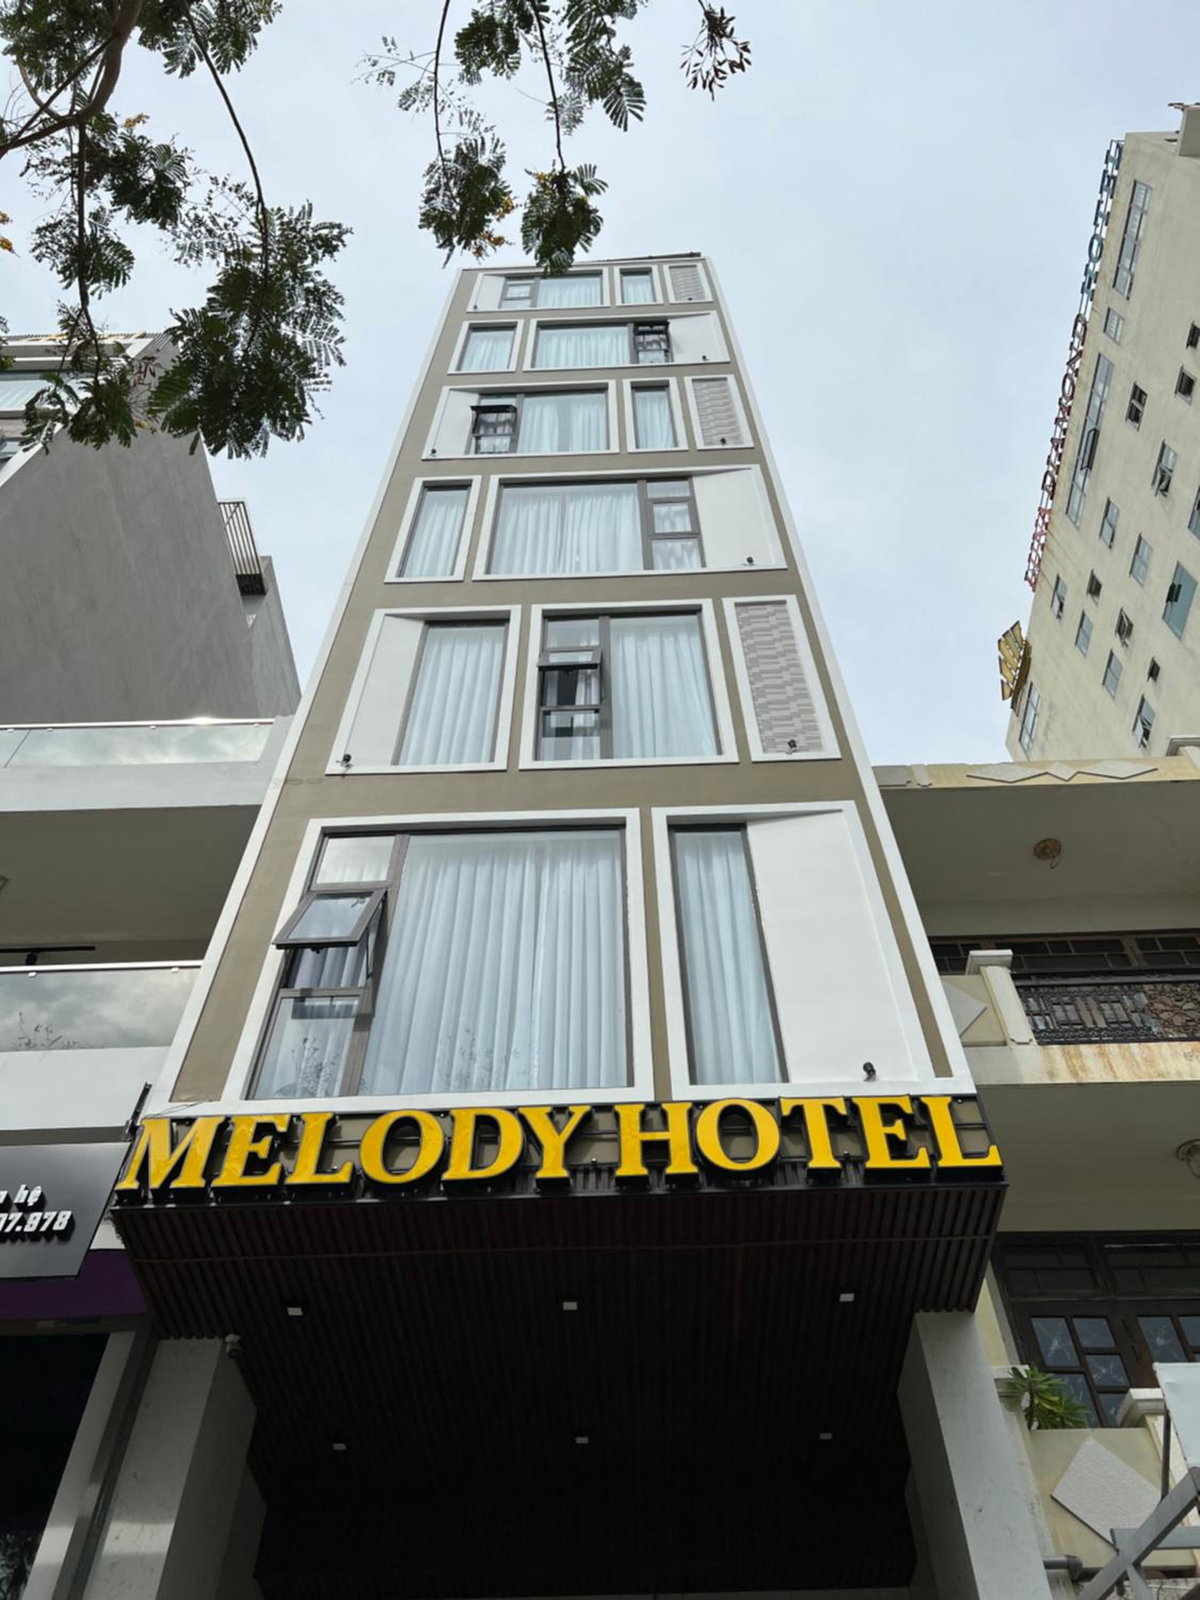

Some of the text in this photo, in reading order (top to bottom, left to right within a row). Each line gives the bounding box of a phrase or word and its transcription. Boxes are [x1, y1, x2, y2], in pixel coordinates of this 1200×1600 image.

[1041, 313, 1088, 500] DIAMOND
[1080, 142, 1124, 302] HOTEL
[114, 1095, 1003, 1190] MELODY HOTEL
